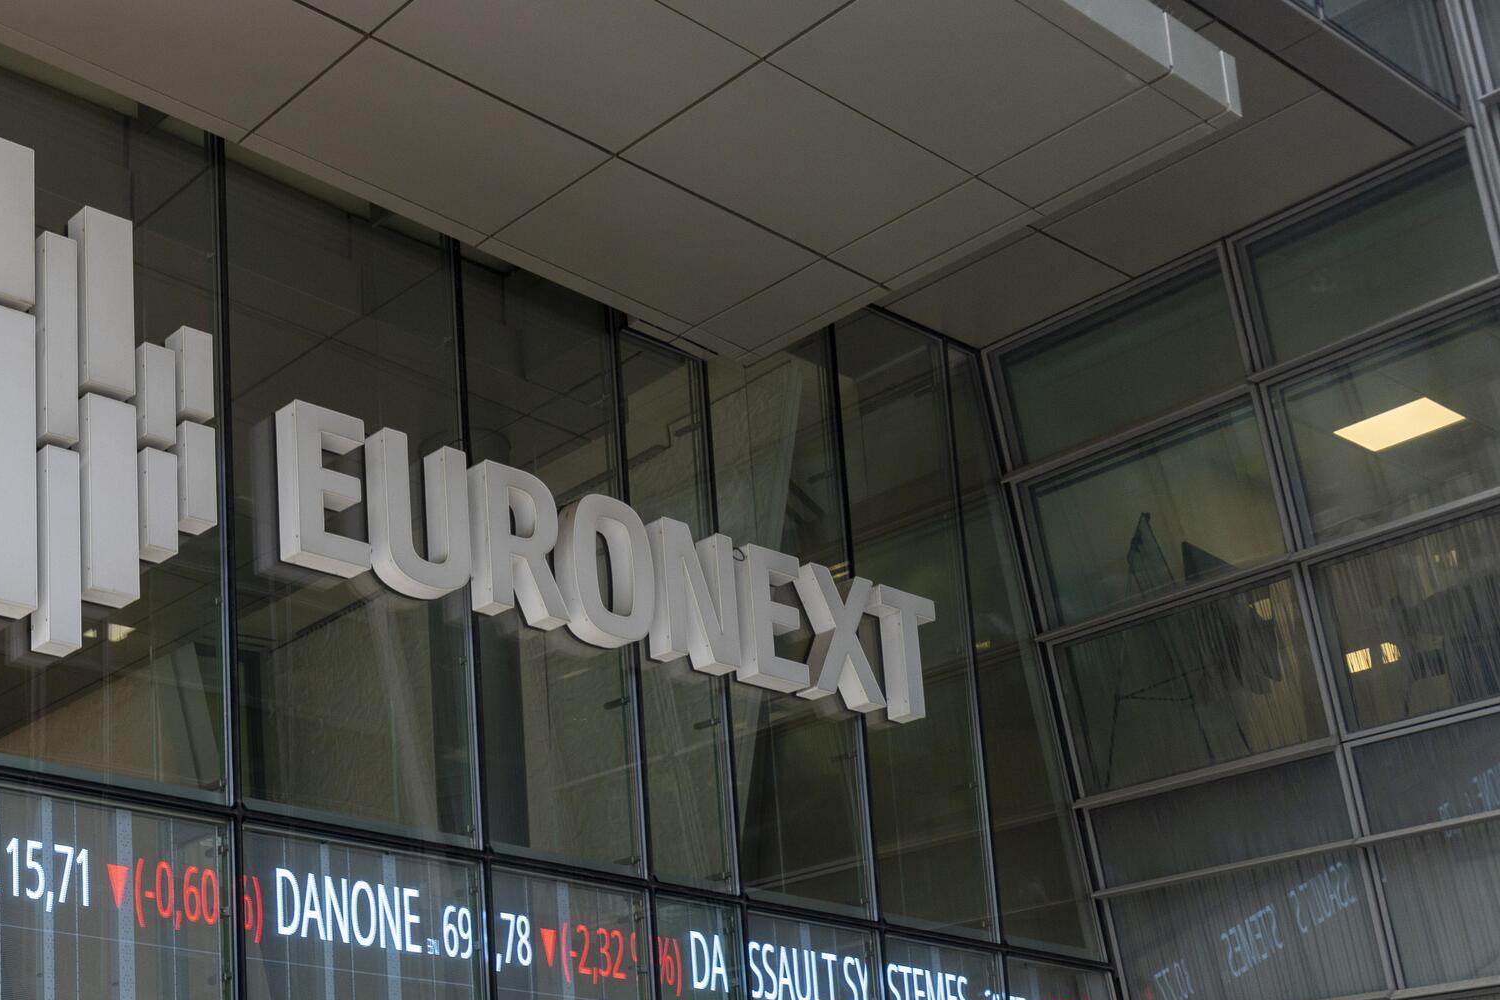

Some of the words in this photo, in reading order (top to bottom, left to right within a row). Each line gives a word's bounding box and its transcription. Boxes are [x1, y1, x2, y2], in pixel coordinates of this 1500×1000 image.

[275, 399, 936, 724] EURONEXT
[5, 837, 90, 913] 15,71
[275, 867, 423, 953] DANONE
[442, 905, 533, 972] 69,78
